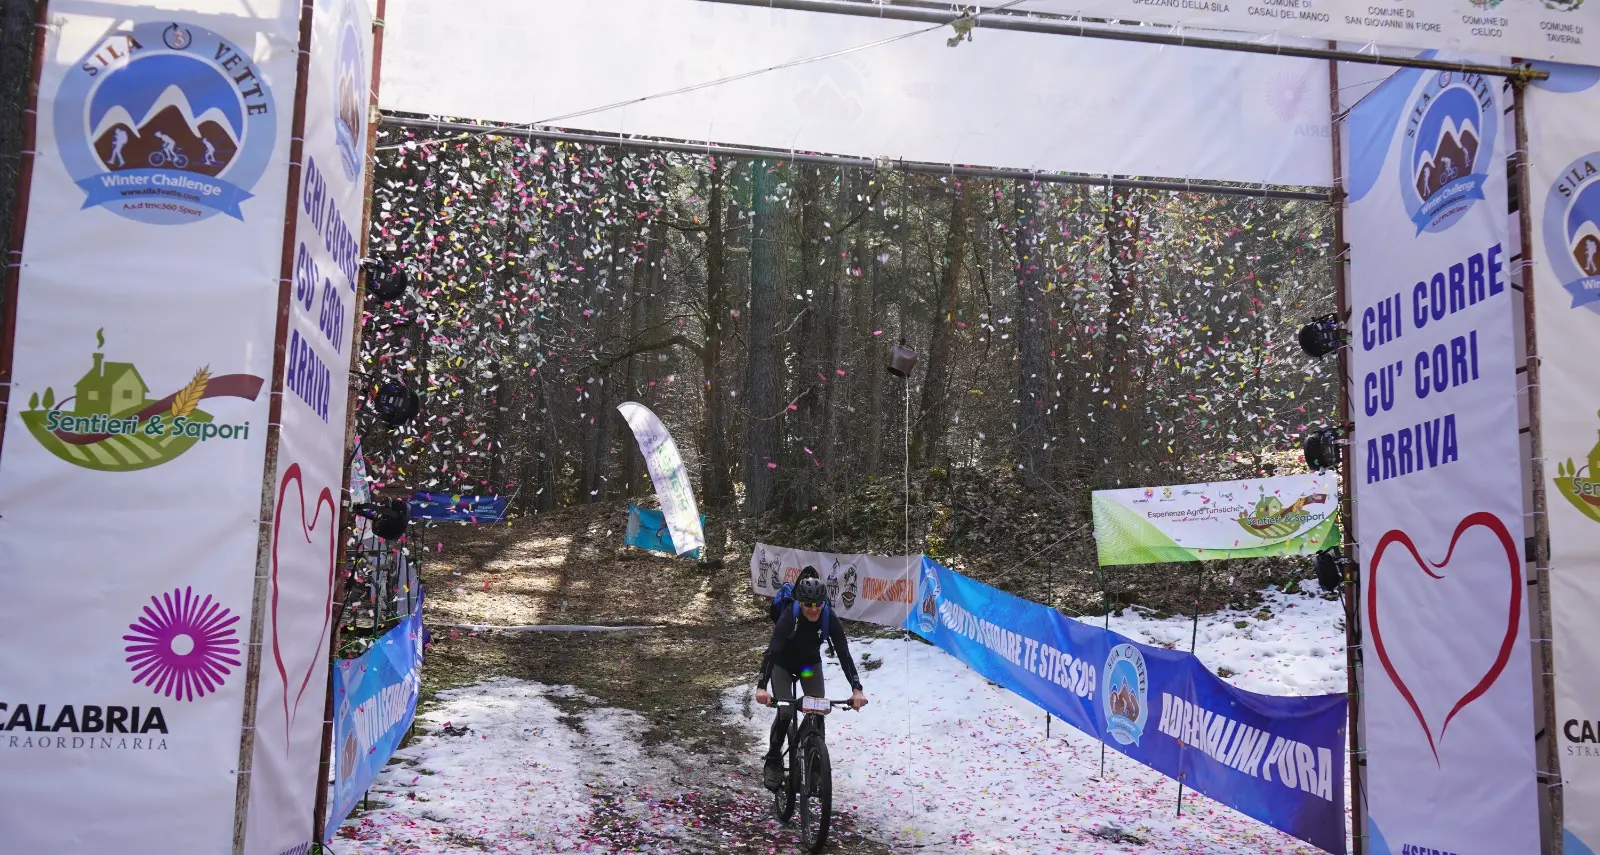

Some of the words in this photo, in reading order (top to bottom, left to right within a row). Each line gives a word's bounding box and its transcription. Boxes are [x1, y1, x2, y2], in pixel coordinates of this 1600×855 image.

[1182, 0, 1209, 11] DELLA
[1211, 3, 1230, 13] SILA
[1248, 6, 1279, 18] CASALI
[1280, 9, 1298, 19] DEL
[1299, 12, 1330, 22] MANCO
[1368, 6, 1404, 17] COMUNE
[1406, 9, 1415, 18] DI
[1344, 16, 1363, 26] SAN
[1364, 17, 1404, 29] GIOVANNI
[1405, 20, 1415, 30] IN
[1416, 22, 1442, 33] FIORE
[1462, 15, 1498, 26] COMUNE
[1500, 18, 1509, 27] DI
[1471, 27, 1503, 38] CELICO
[1540, 21, 1574, 33] COMUNE
[1575, 25, 1584, 34] DI
[1546, 33, 1582, 45] TAVERNA
[82, 35, 143, 77] SILA
[213, 42, 268, 117] VETTE
[1407, 90, 1431, 139] SILA
[100, 173, 149, 188] Winter
[151, 173, 222, 197] Challenge
[1558, 160, 1597, 198] SILA
[178, 205, 202, 217] Sport
[303, 155, 327, 236] CHI
[325, 197, 359, 293] CORRE
[1361, 292, 1403, 352] CHI
[1413, 242, 1505, 330] CORRE
[319, 276, 345, 354] CORI
[287, 328, 331, 424] ARRIVA
[1364, 360, 1403, 418] CU'
[1415, 330, 1480, 400] CORI
[46, 410, 138, 436] Sentieri
[145, 414, 165, 436] &
[172, 415, 250, 442] Sapori
[1366, 413, 1459, 485] ARRIVA
[1147, 509, 1186, 519] Esperienze
[1294, 511, 1325, 524] Sapori
[939, 597, 976, 641] PRONTO
[982, 618, 1023, 667] SFIDARE
[1024, 636, 1039, 675] TE
[1038, 643, 1096, 702] STESSO?
[1564, 719, 1600, 744] CA
[1158, 691, 1269, 778] ADRENALINA
[1263, 734, 1333, 802] PURA
